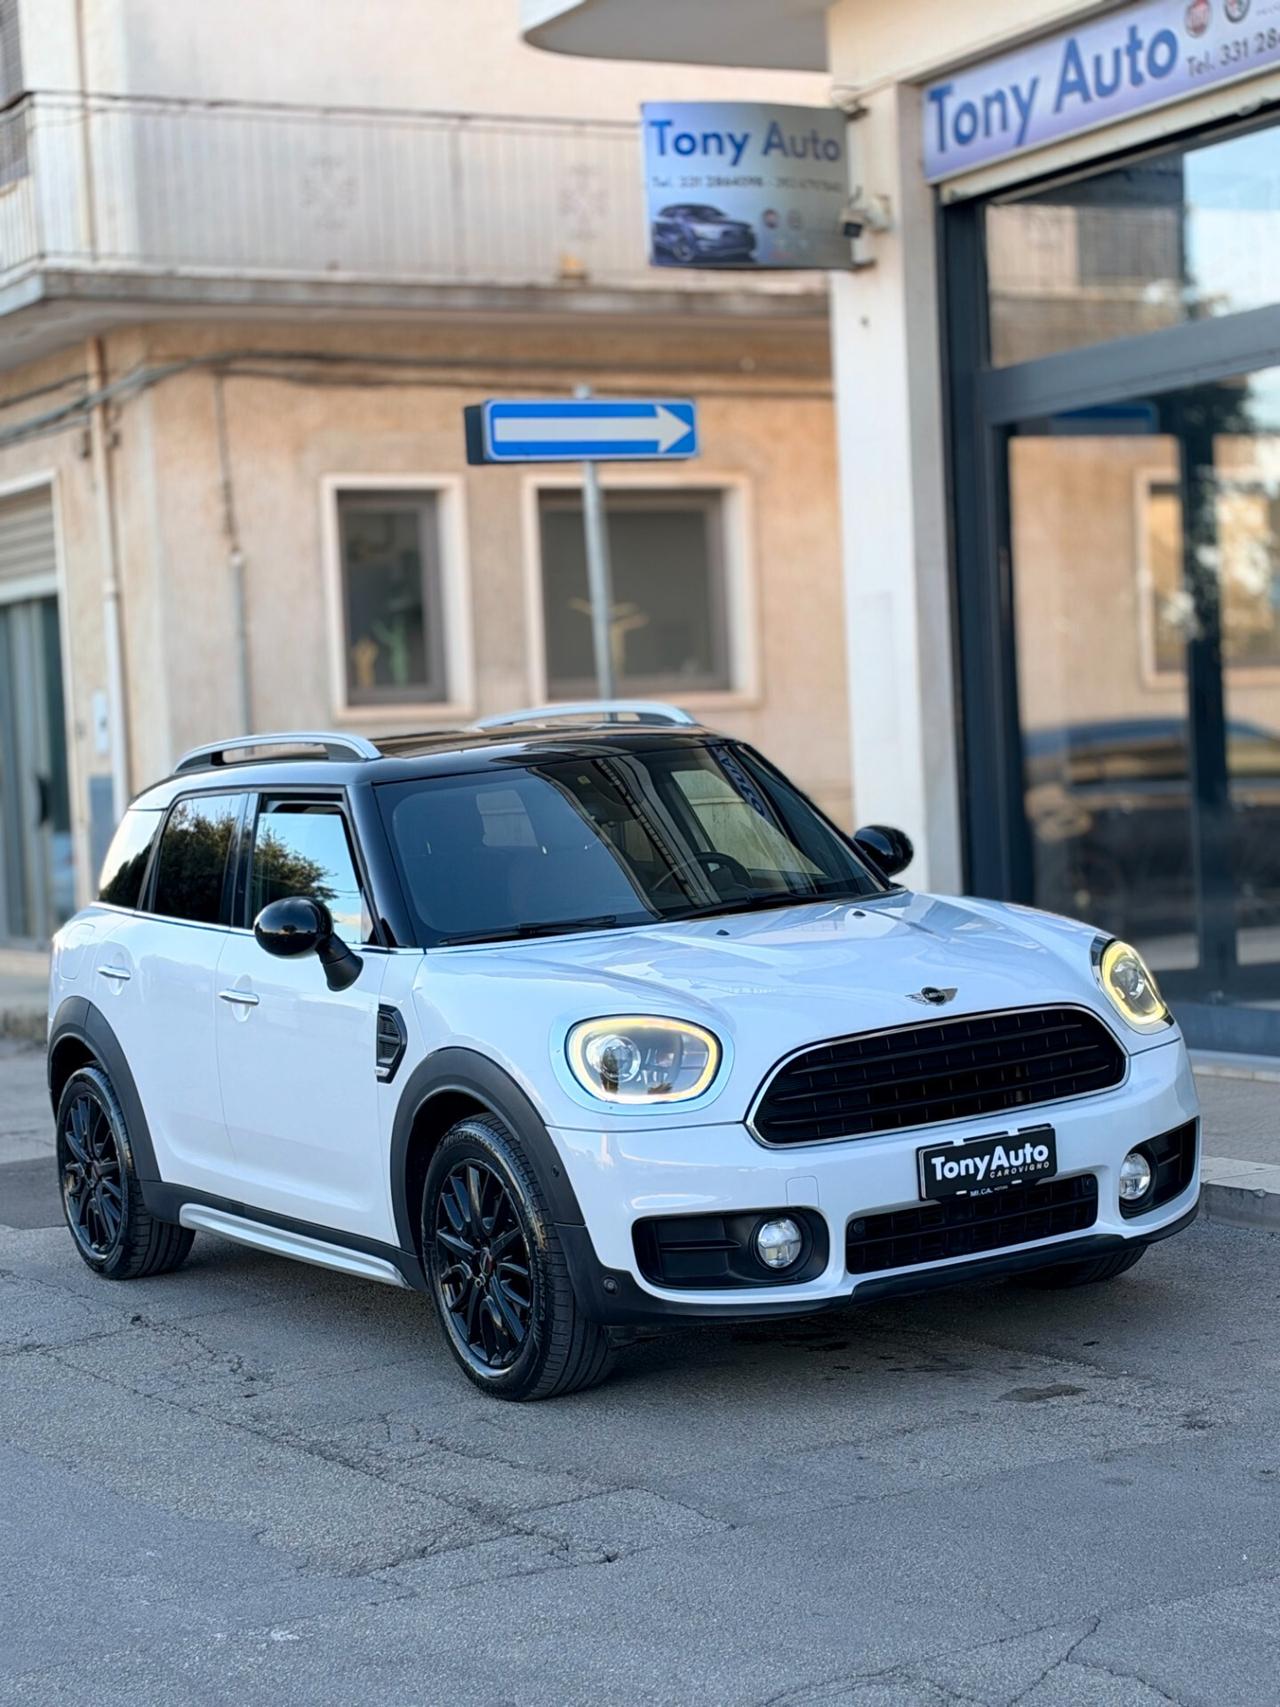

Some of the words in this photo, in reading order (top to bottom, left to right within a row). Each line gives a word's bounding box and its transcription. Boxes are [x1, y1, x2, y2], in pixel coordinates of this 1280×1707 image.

[1187, 50, 1216, 77] Tel.
[1220, 37, 1249, 67] 331
[1254, 27, 1280, 53] 28
[928, 77, 1039, 154] Tony
[1053, 25, 1178, 114] Auto
[649, 120, 750, 167] Tony
[762, 121, 841, 162] Auto
[990, 1161, 1050, 1179] CAROVIGNO
